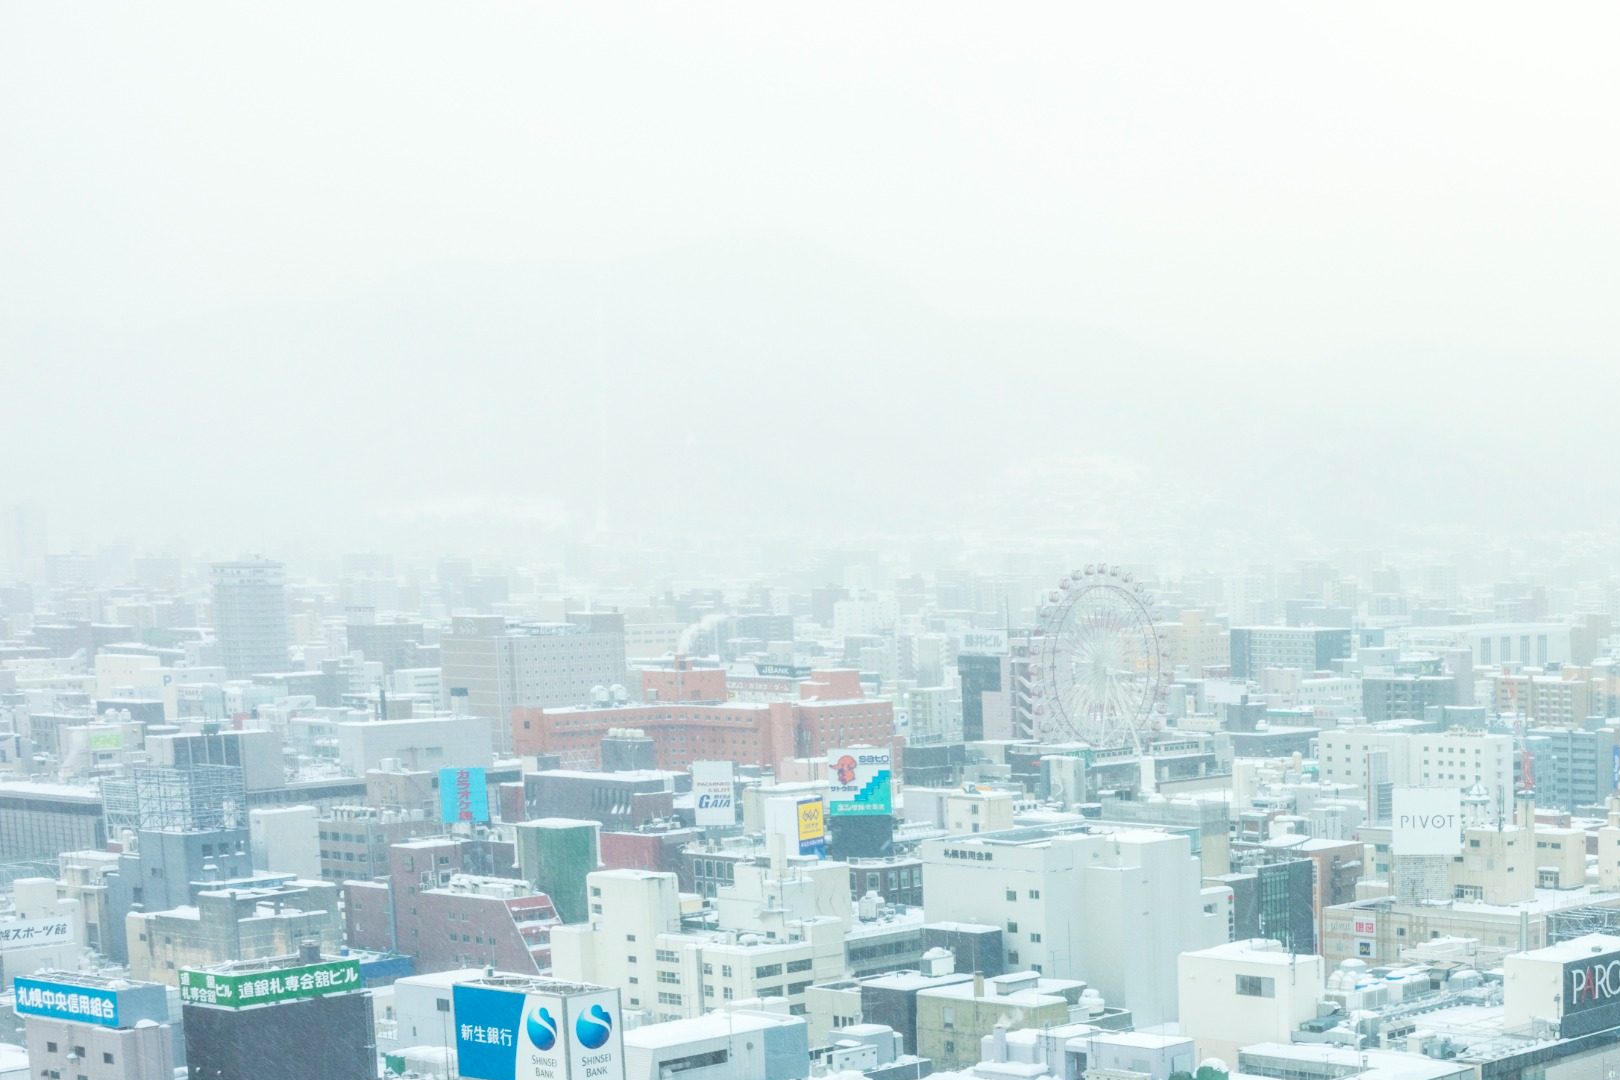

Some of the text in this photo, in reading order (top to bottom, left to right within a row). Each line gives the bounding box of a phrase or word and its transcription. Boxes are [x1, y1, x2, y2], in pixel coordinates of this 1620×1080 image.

[1400, 814, 1455, 829] PIVOT
[461, 1023, 513, 1047] 新生銀行
[535, 1066, 555, 1079] BANK
[586, 1066, 609, 1078] BANK
